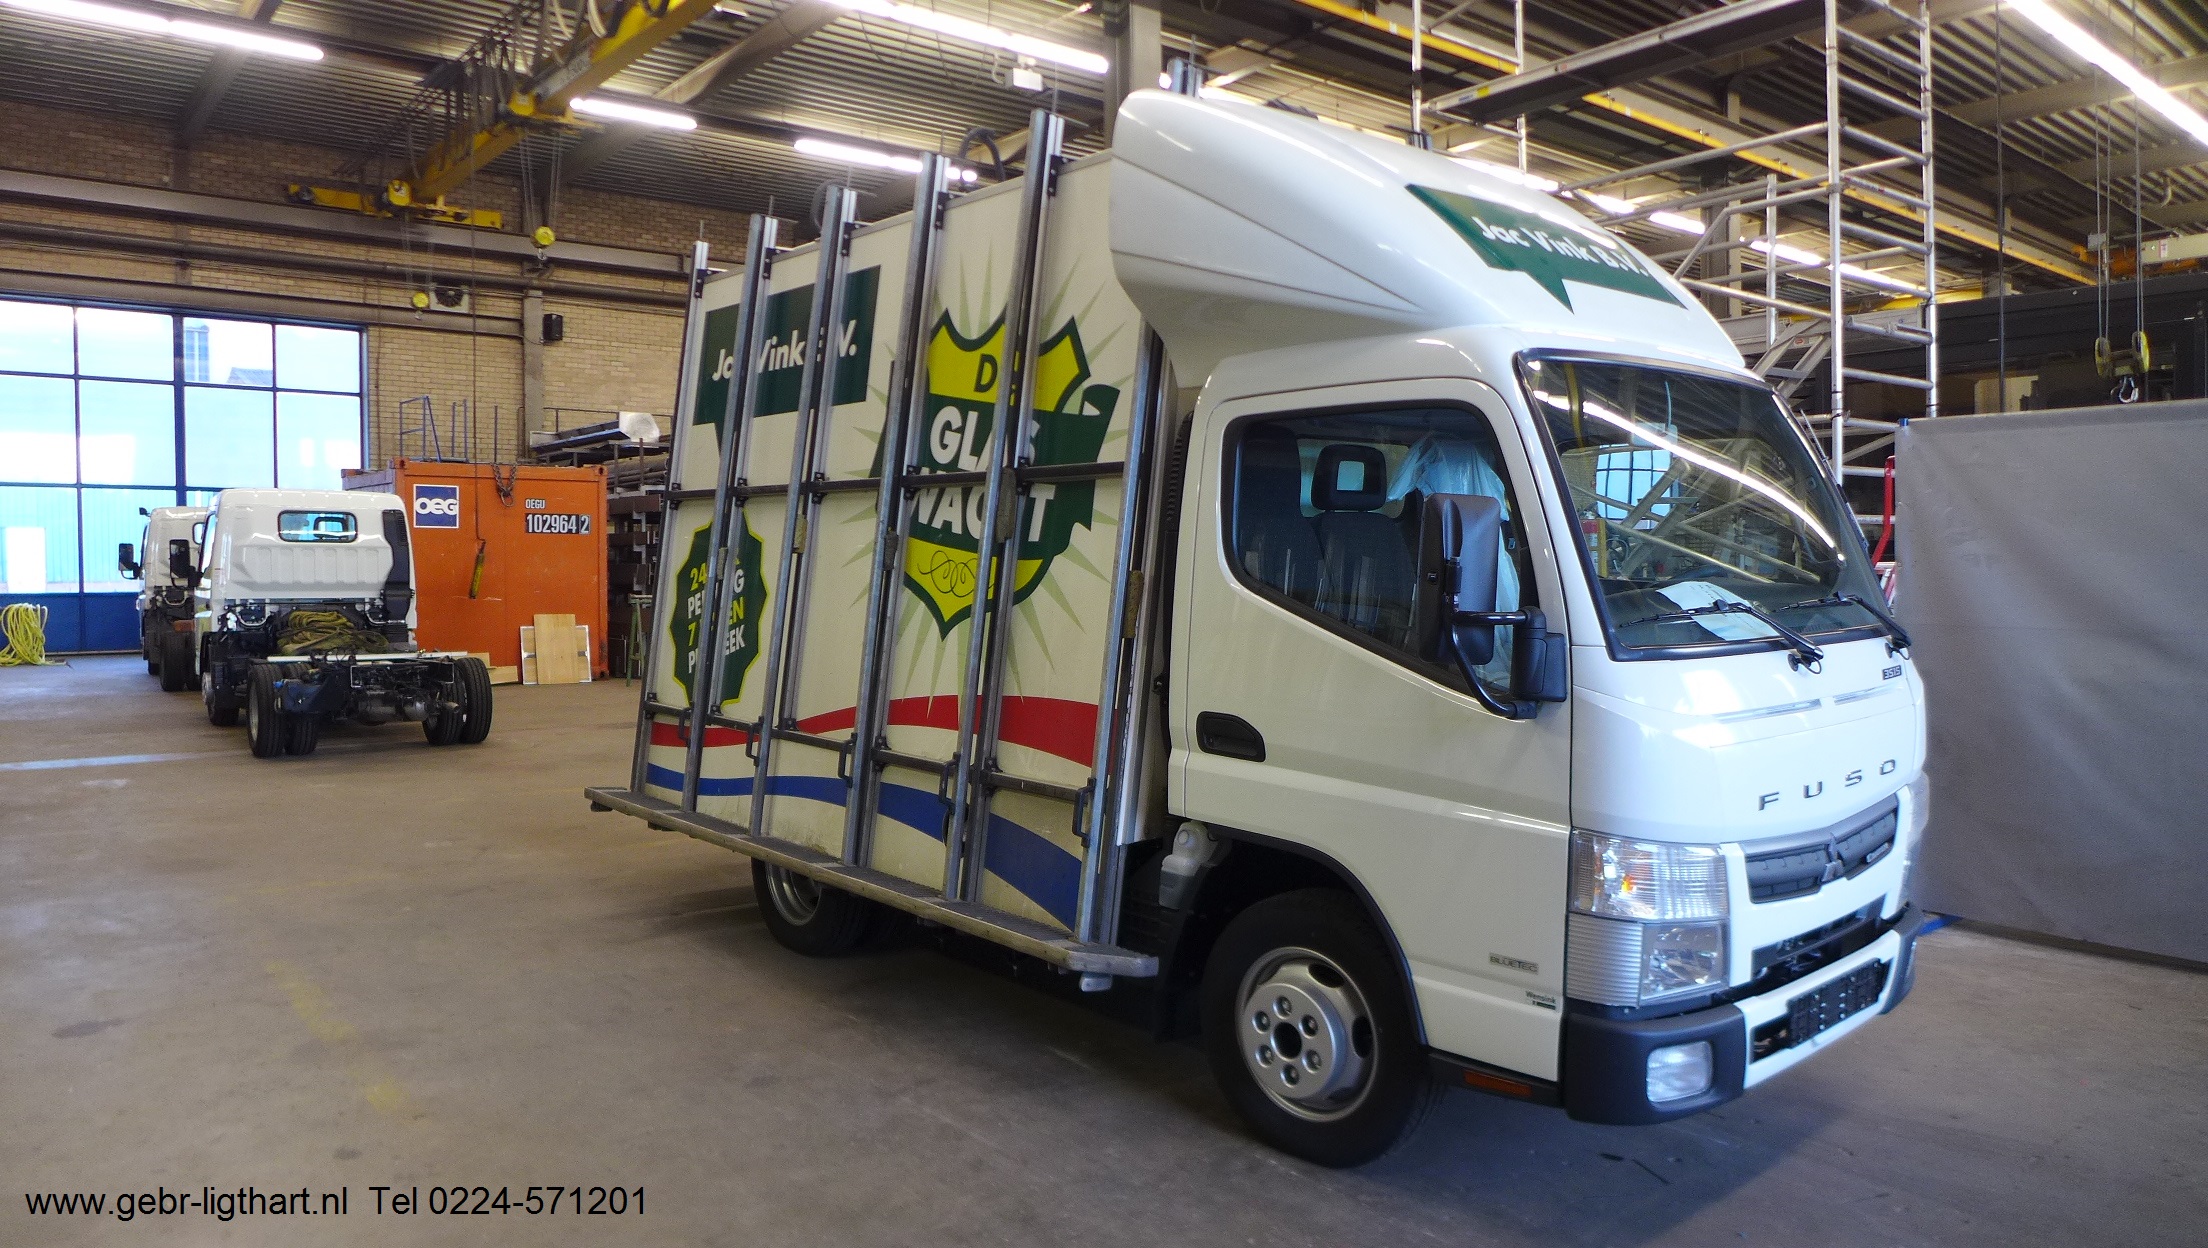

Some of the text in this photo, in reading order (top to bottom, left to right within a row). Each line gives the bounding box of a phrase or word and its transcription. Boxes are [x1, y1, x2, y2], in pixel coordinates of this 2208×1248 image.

[1471, 216, 1649, 278] Jac Vink B.V.
[711, 348, 736, 382] Ja
[525, 498, 546, 510] OEGU
[526, 514, 590, 534] 102964 2
[690, 562, 708, 592] 24
[687, 589, 706, 620] PE
[687, 621, 698, 647] 7
[724, 624, 746, 656] EEK
[1758, 758, 1897, 812] FUSO
[1489, 955, 1538, 974] BLUETEC
